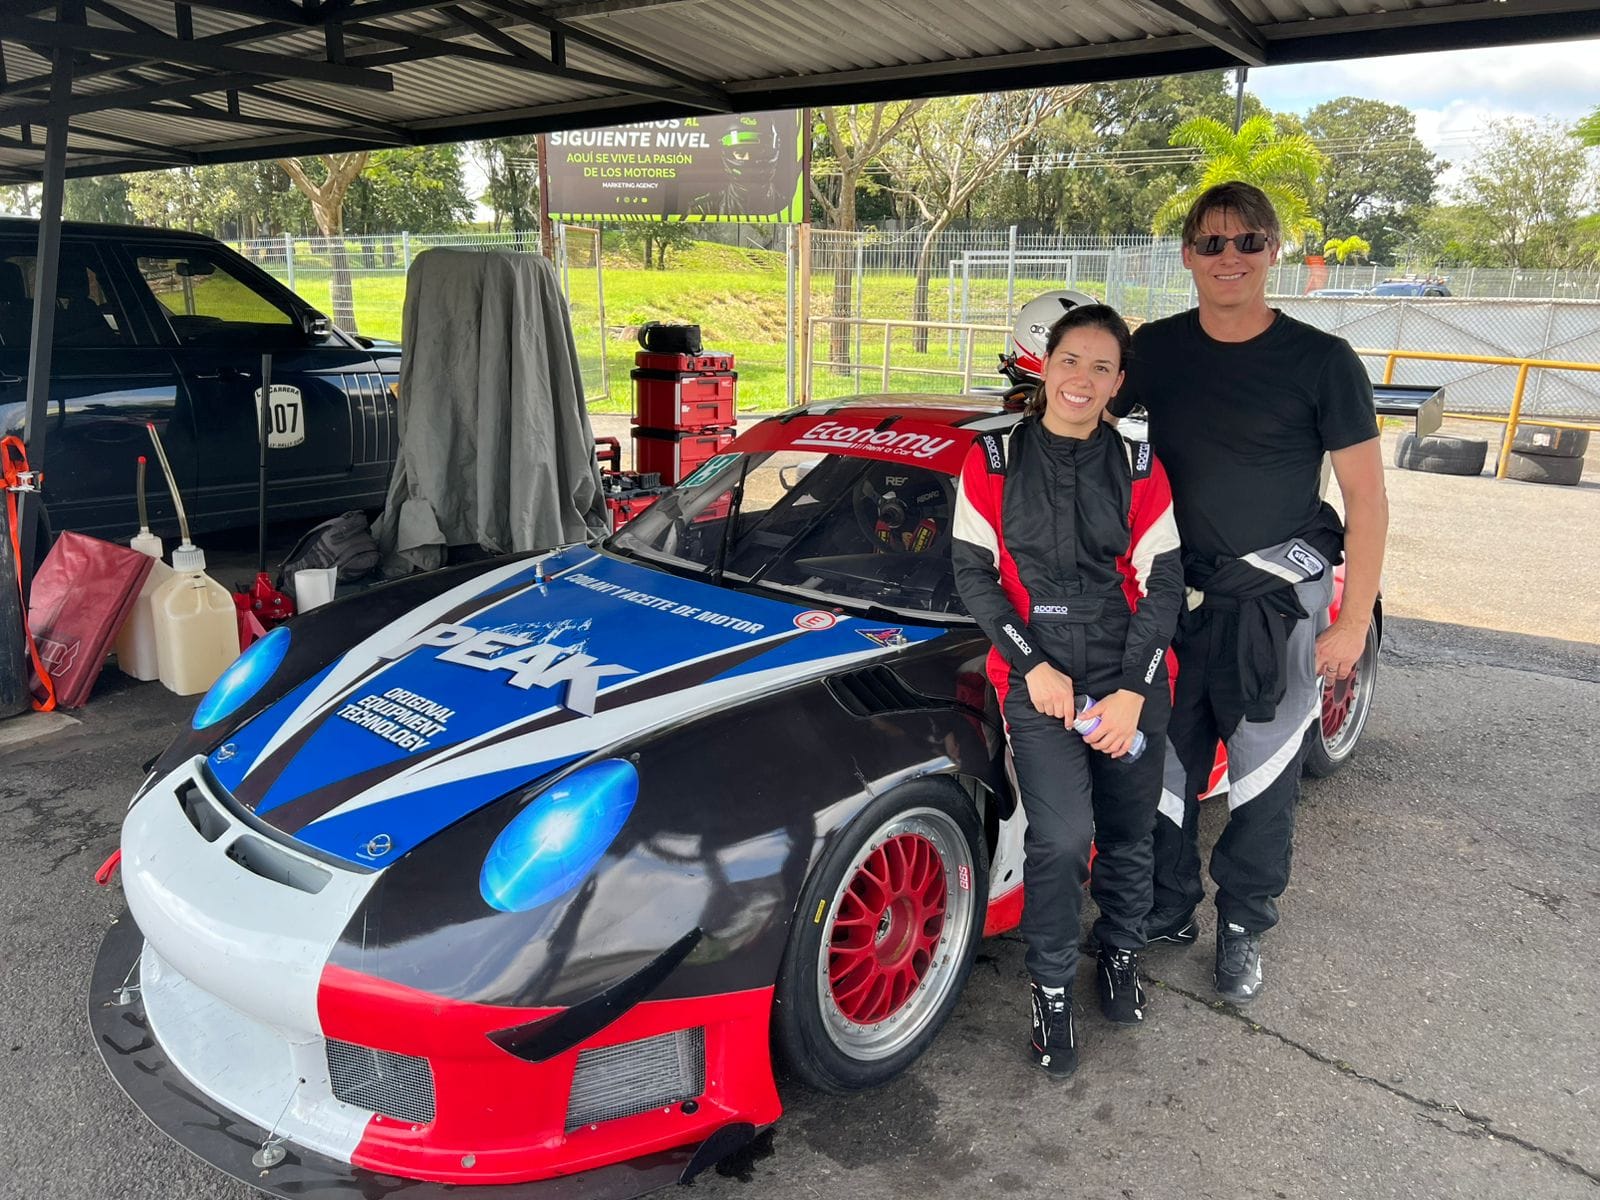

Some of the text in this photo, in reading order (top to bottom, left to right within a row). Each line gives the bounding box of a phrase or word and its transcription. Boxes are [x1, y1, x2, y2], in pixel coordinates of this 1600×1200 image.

[684, 117, 699, 127] AL
[550, 131, 710, 148] SIGUIENTE NIVEL
[566, 151, 692, 164] AQUÍ SE VIVE LA PASIÓN
[583, 167, 676, 178] DE LOS MOTORES
[265, 403, 299, 434] 07
[802, 421, 955, 458] Economy
[862, 443, 885, 452] Rent
[893, 448, 912, 456] Car
[618, 591, 679, 611] ACEITE
[670, 604, 702, 618] DE
[693, 610, 765, 634] MOTOR
[1033, 605, 1068, 615] sparco
[1002, 623, 1032, 656] sparco
[377, 623, 640, 718] PEAK
[1144, 648, 1164, 685] sparco
[357, 694, 447, 738] EQUIPMENT
[383, 687, 456, 724] ORIGINAL
[336, 704, 431, 753] TECHNOLOGY
